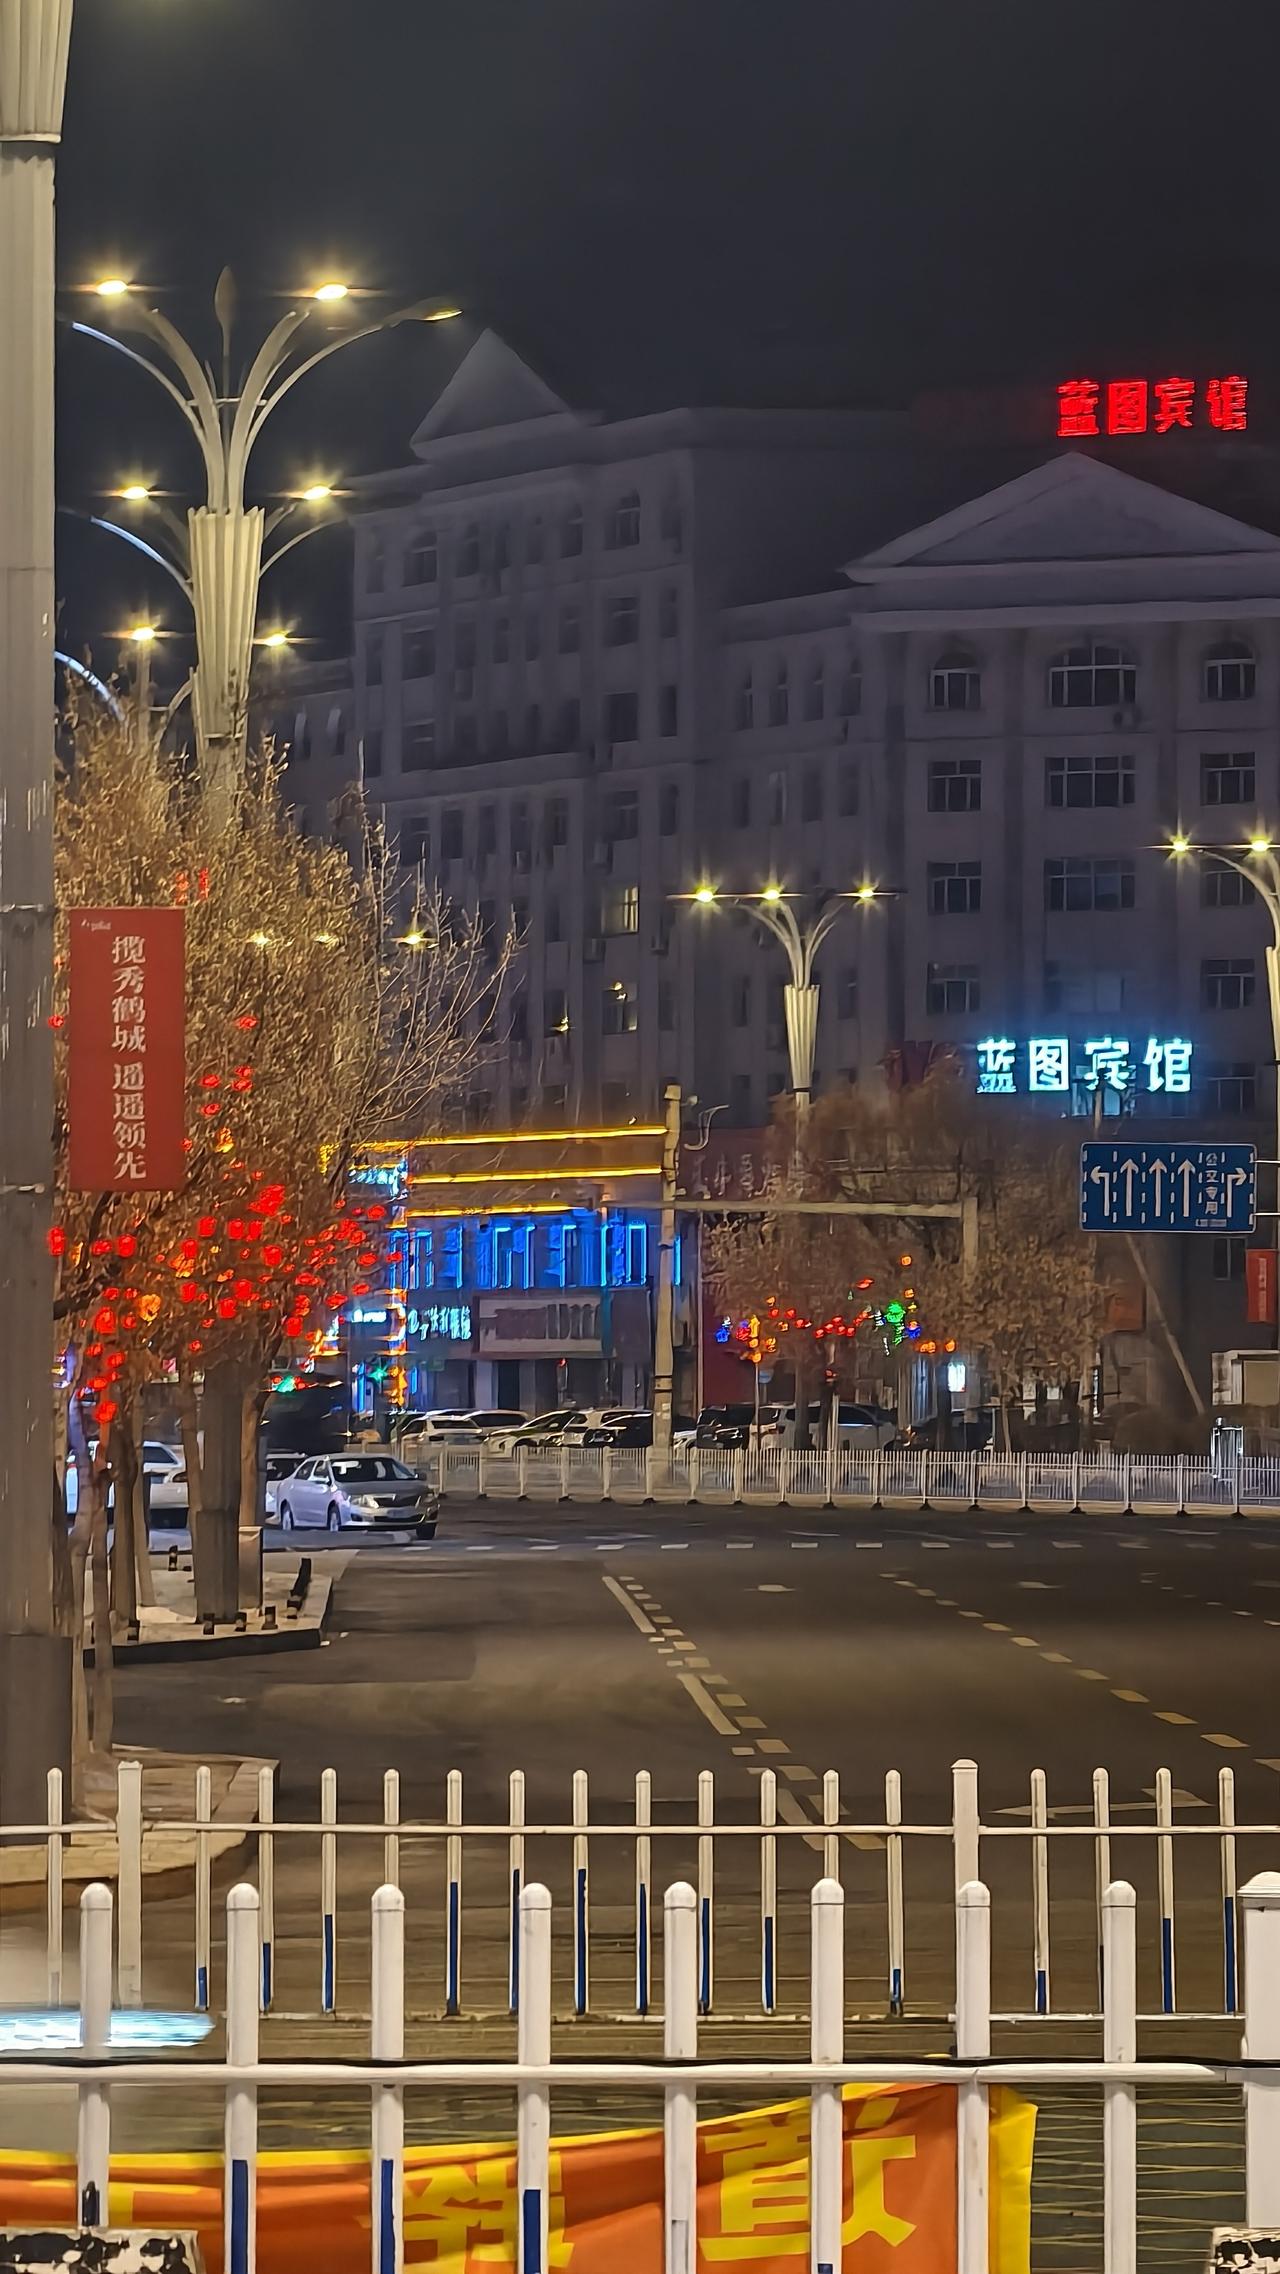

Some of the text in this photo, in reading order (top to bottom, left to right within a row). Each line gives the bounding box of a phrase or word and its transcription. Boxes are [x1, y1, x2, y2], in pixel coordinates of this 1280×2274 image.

[1056, 375, 1249, 437] 蓝图宾馆
[111, 935, 147, 1053] 揽秀鹤城
[975, 1036, 1194, 1093] 蓝图宾馆
